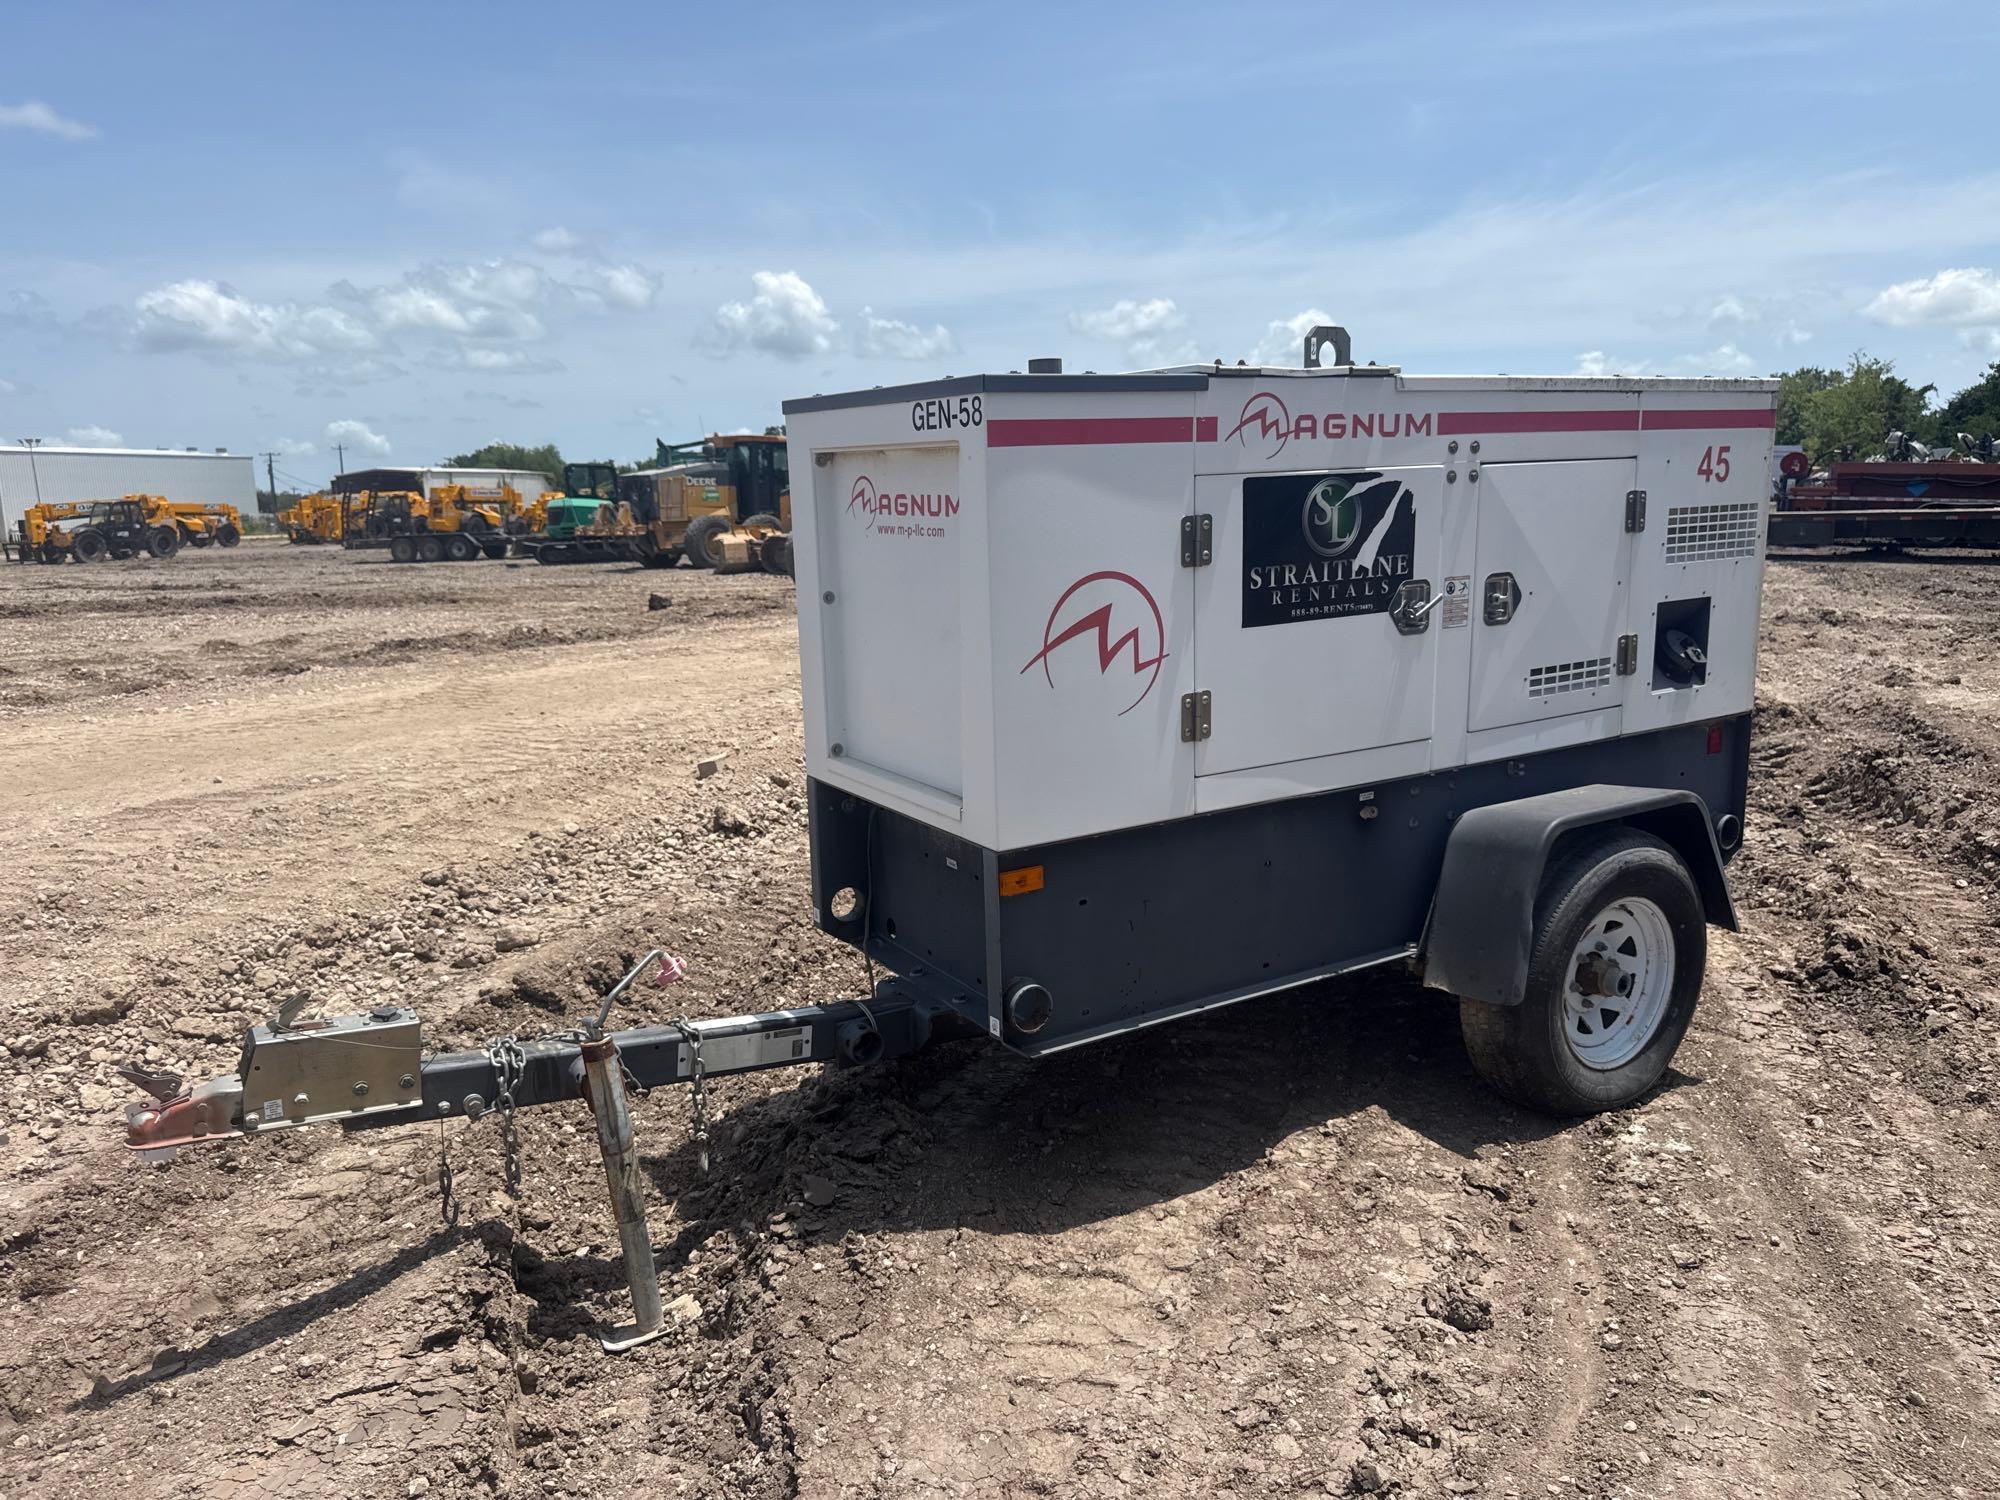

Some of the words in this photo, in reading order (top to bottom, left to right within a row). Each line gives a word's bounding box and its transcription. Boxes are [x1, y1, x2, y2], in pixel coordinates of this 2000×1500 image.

[912, 395, 983, 431] GEN-58
[1697, 445, 1731, 483] 45
[687, 476, 717, 486] DEERE
[877, 523, 945, 539] wwwm-p-llccom
[1272, 579, 1389, 605] RENTALS
